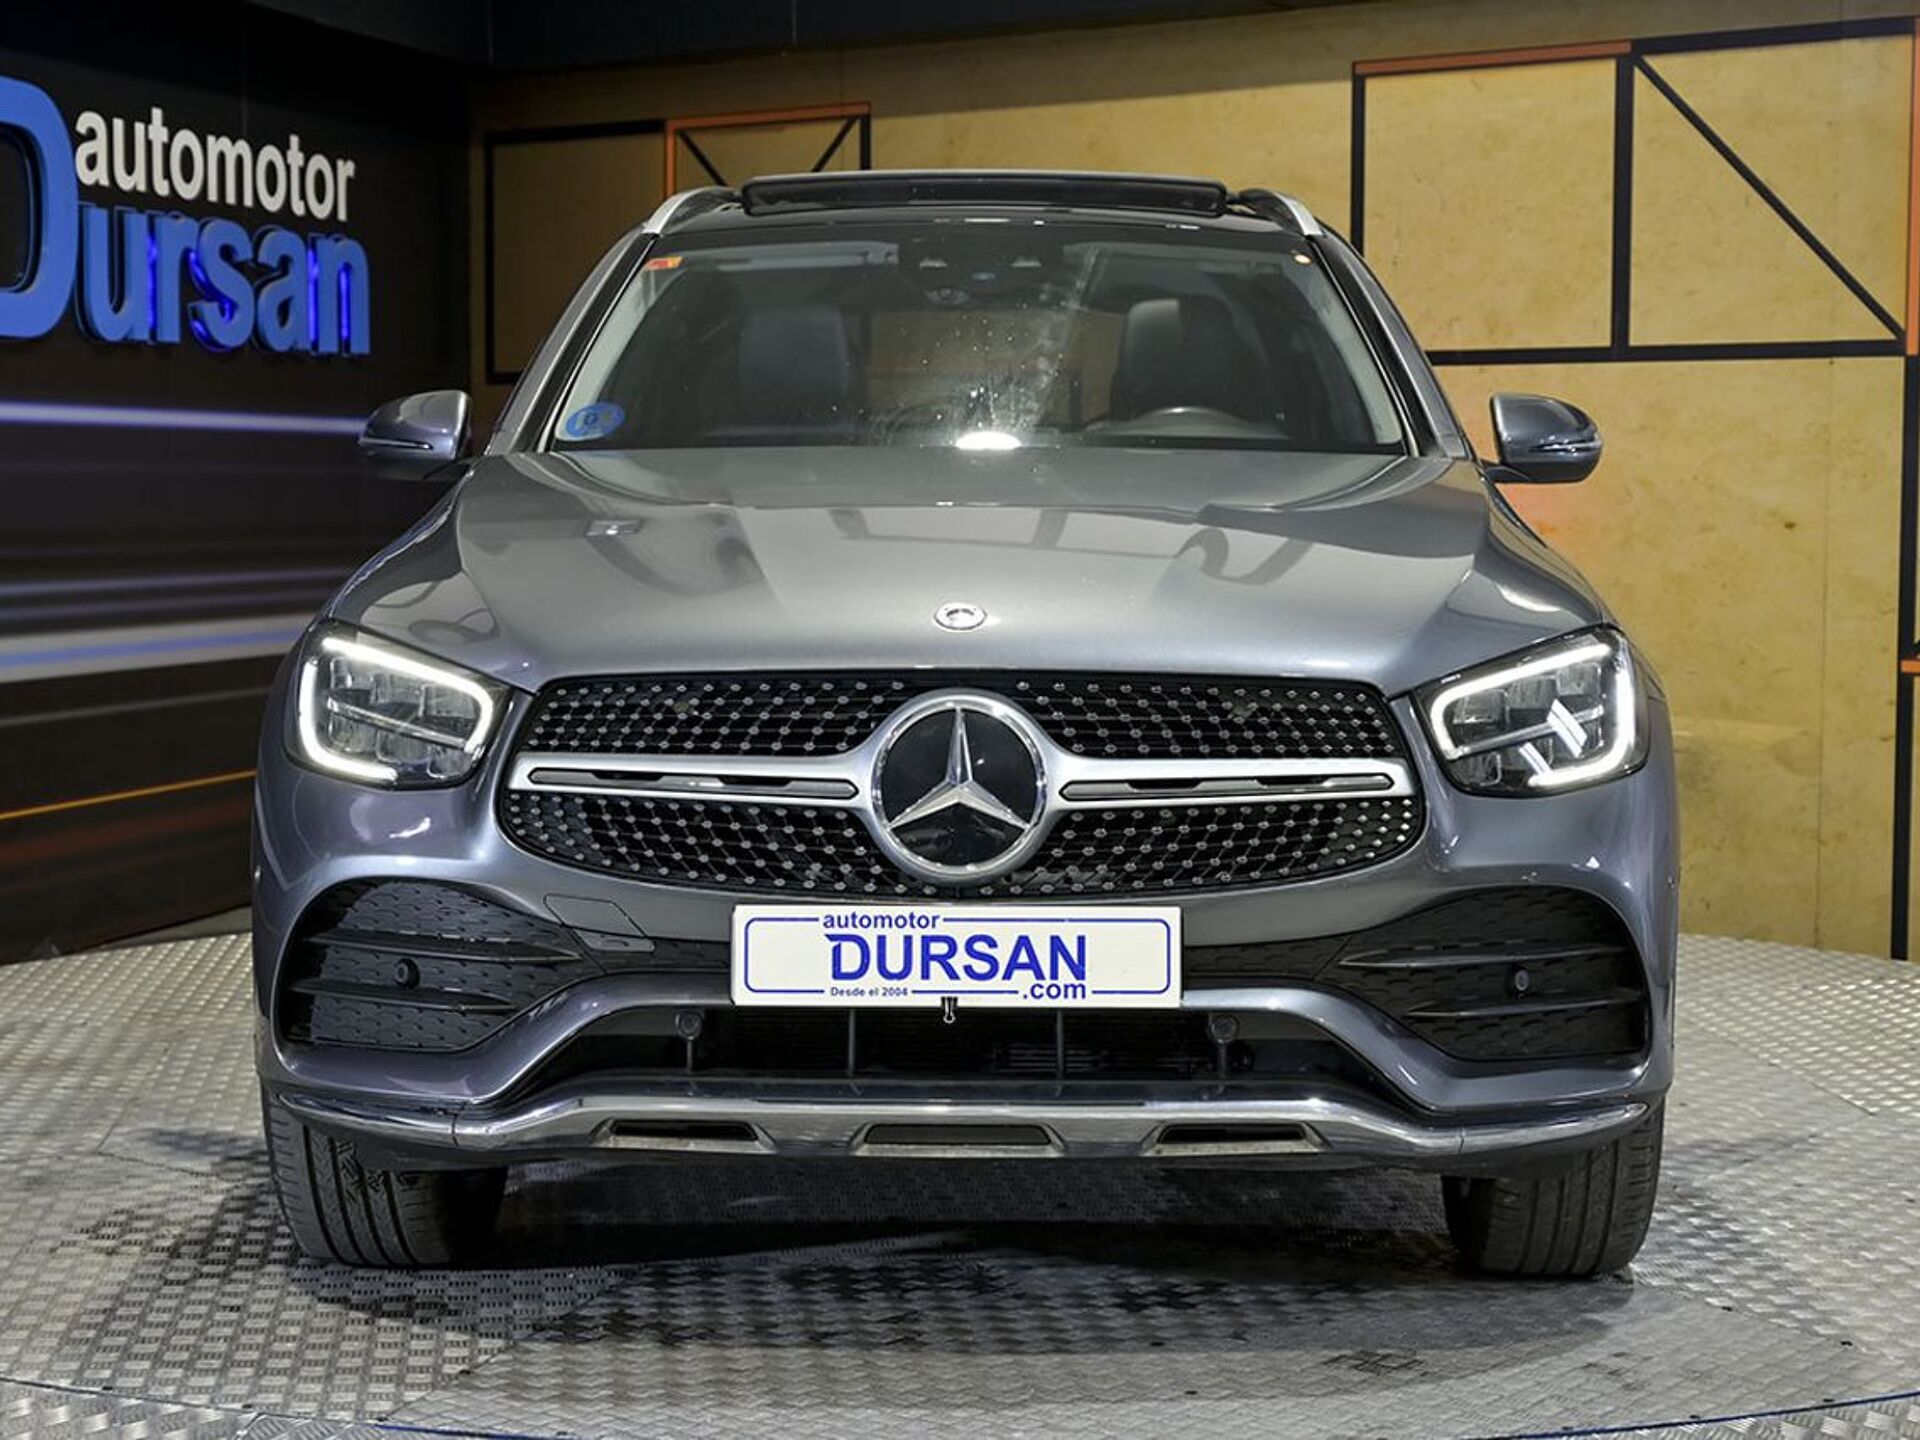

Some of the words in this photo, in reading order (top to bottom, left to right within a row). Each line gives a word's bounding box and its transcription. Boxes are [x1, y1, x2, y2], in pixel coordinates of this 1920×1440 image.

[75, 107, 355, 222] automotor
[822, 912, 940, 929] automotor
[825, 934, 1086, 981] DURSAN
[830, 986, 865, 997] Desde
[868, 986, 879, 997] el
[1022, 982, 1086, 1000] .com
